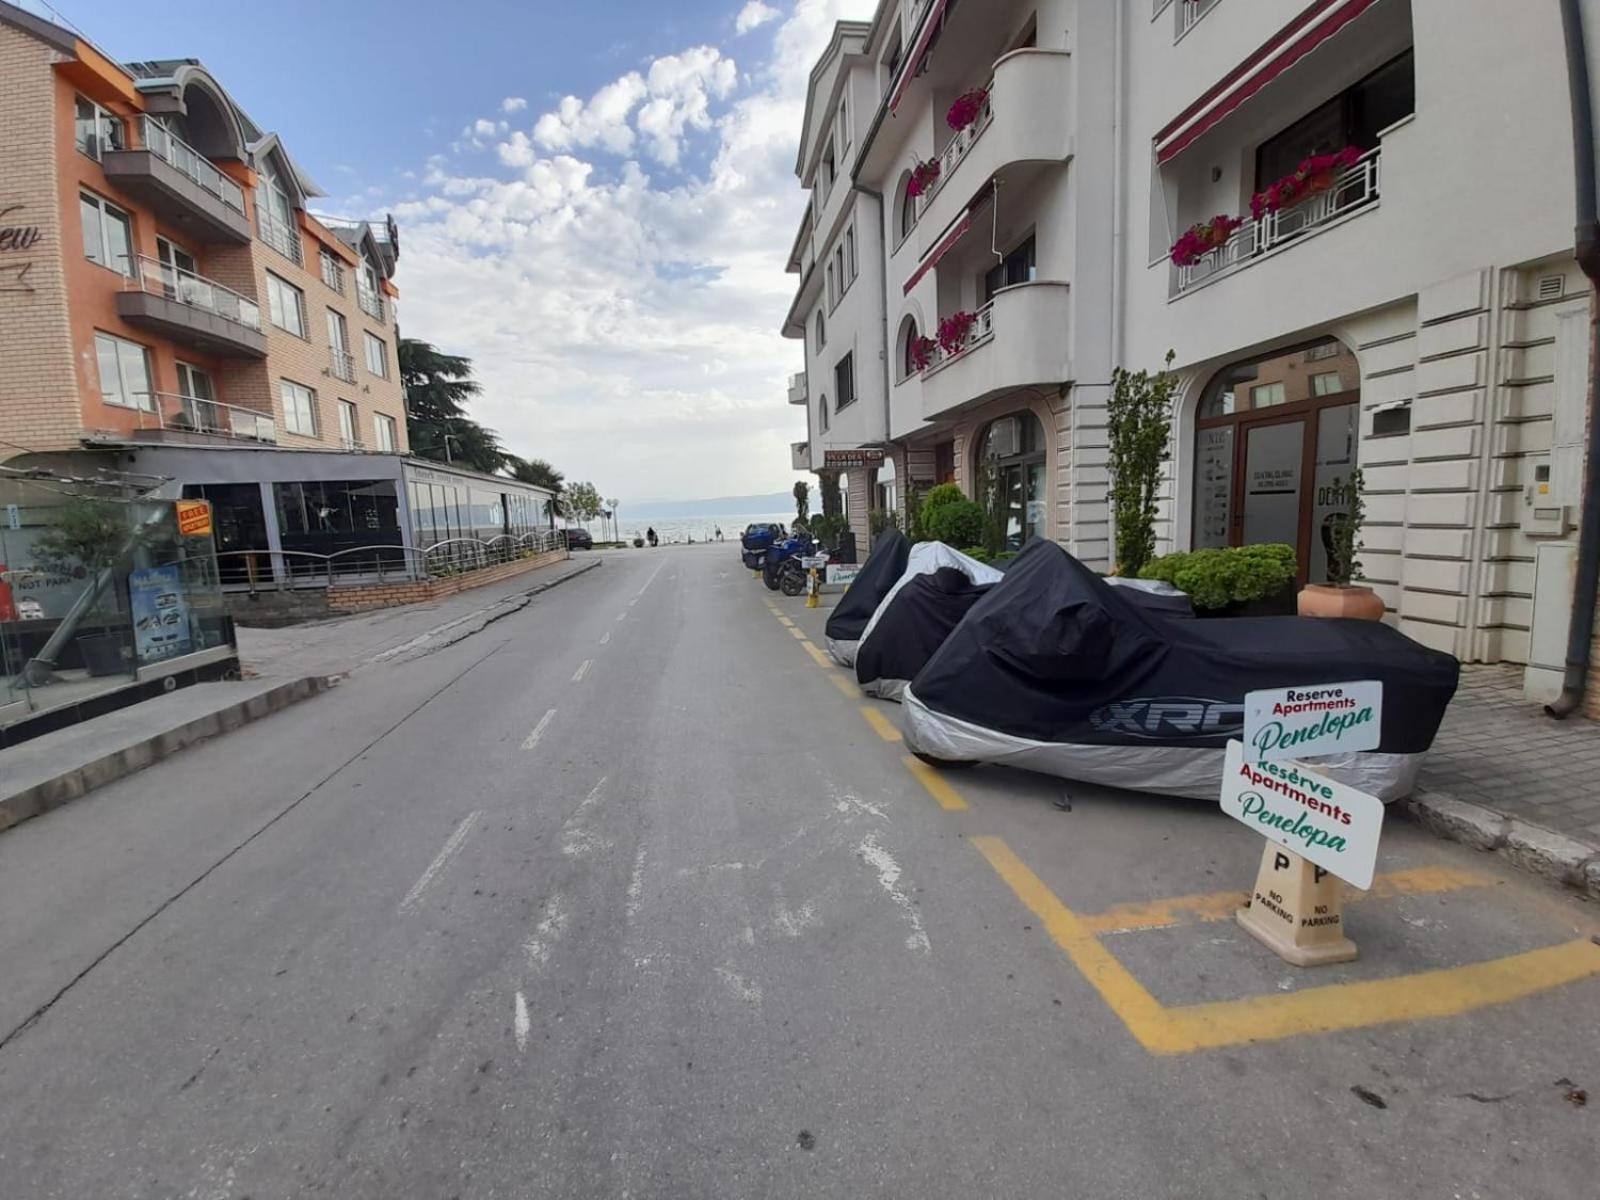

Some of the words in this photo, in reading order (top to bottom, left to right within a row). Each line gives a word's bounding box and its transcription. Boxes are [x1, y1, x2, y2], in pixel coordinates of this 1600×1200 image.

[1286, 688, 1343, 703] Reserve
[1272, 697, 1356, 716] Apartments
[1252, 705, 1373, 760] Penelopa
[1239, 763, 1352, 826] Apartments
[1237, 790, 1347, 853] Penelopa
[1274, 852, 1290, 872] P
[1268, 890, 1283, 905] NO
[1255, 892, 1294, 925] PARKING
[1314, 905, 1328, 915] NO
[1301, 914, 1340, 928] PARKING
